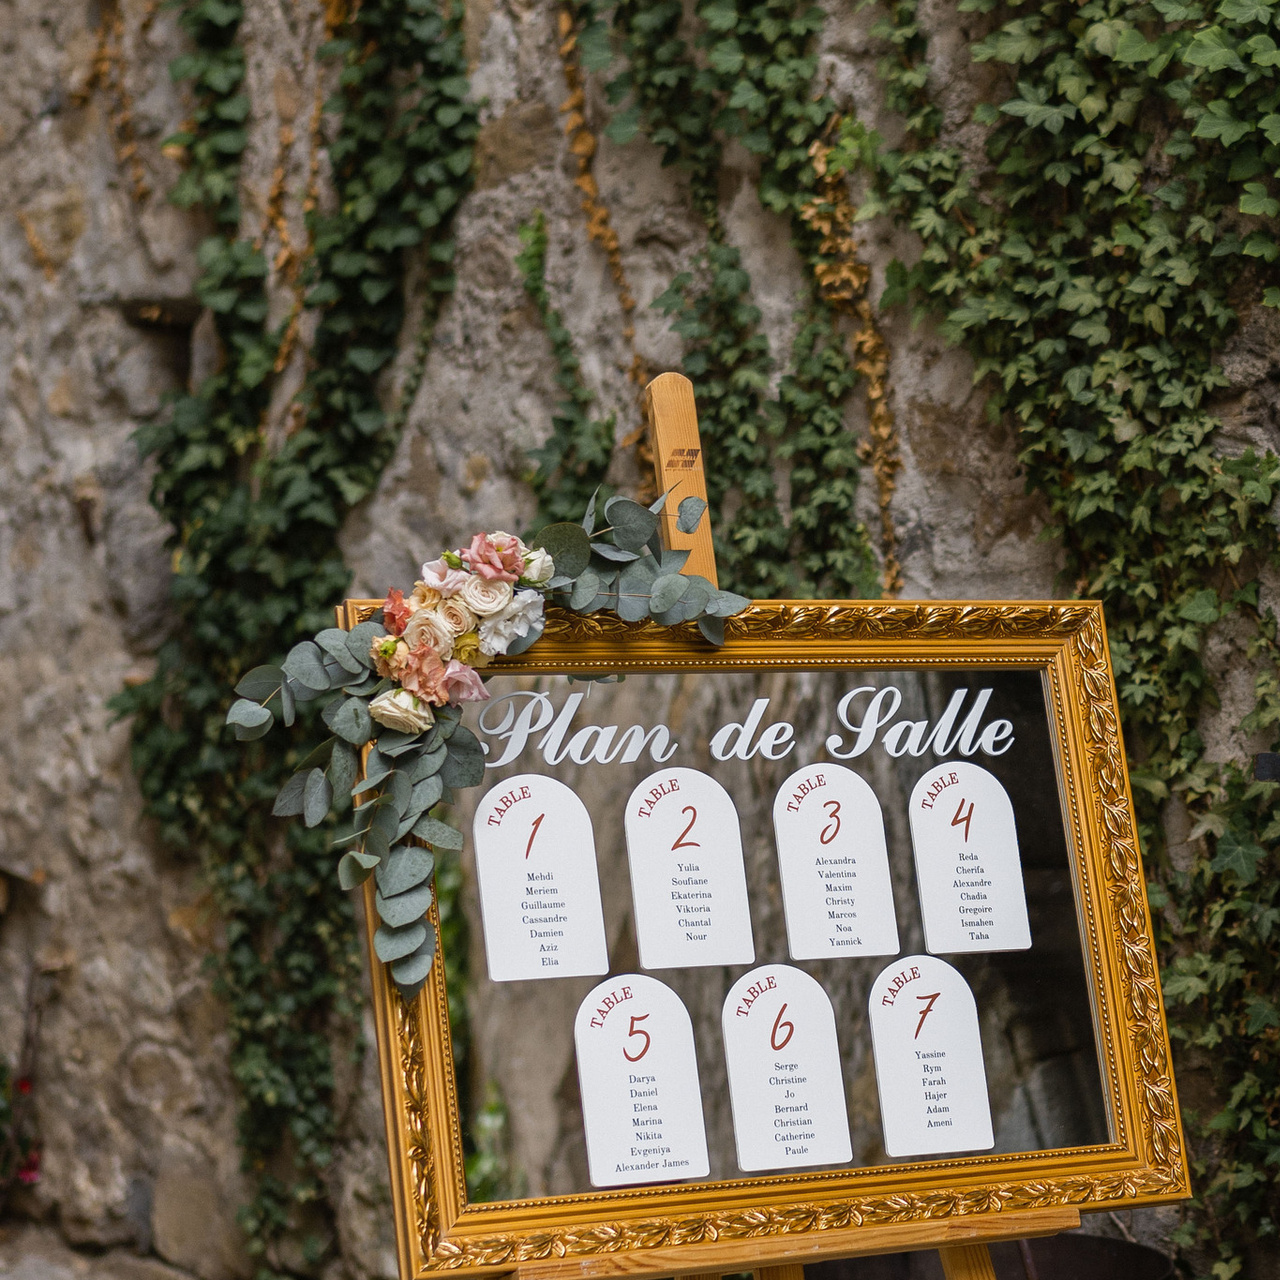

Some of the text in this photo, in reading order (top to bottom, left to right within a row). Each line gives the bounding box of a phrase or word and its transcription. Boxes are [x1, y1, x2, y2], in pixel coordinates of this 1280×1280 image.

[479, 686, 1015, 768] Plan de Salle
[787, 774, 826, 813] TABLE
[921, 772, 959, 810] TABLE
[638, 778, 680, 819] TABLE
[488, 785, 532, 827] TABLE
[820, 800, 841, 845] 3
[951, 798, 974, 843] 4
[671, 805, 701, 851] 2
[525, 813, 545, 860] 1
[815, 856, 856, 866] Alexandra
[959, 853, 978, 861] Reda
[677, 863, 700, 872] Yulia
[956, 866, 984, 874] Cherifa
[527, 872, 554, 882] Mehdi
[818, 871, 856, 879] Valentina
[672, 878, 708, 886] Soufiane
[953, 879, 992, 888] Alexandre
[526, 886, 558, 895] Meriem
[825, 884, 852, 892] Maxim
[671, 891, 712, 900] Ekaterina
[960, 892, 987, 900] Chadia
[521, 901, 566, 910] Guillaume
[825, 897, 855, 906] Christy
[676, 905, 711, 914] Viktoria
[959, 906, 992, 915] Gregoire
[522, 915, 568, 924] Cassandre
[828, 911, 856, 919] Marcos
[678, 918, 711, 927] Chantal
[961, 919, 994, 927] Ismahen
[836, 924, 852, 932] Noa
[530, 929, 564, 938] Damien
[686, 932, 707, 941] Nour
[969, 932, 989, 940] Taha
[829, 937, 862, 946] Yannick
[539, 944, 558, 952] Aziz
[541, 958, 559, 966] Elia
[882, 966, 921, 1007] TABLE
[736, 976, 777, 1018] TABLE
[590, 986, 633, 1029] TABLE
[914, 992, 941, 1040] 7
[770, 1003, 794, 1051] 6
[623, 1013, 651, 1062] 5
[915, 1050, 946, 1059] Yassine
[774, 1062, 798, 1072] Serge
[923, 1064, 942, 1073] Rym
[629, 1075, 656, 1084] Darya
[769, 1076, 807, 1086] Christine
[922, 1077, 946, 1087] Farah
[630, 1088, 658, 1098] Daniel
[785, 1090, 795, 1098] Jo
[925, 1092, 947, 1101] Hajer
[633, 1103, 658, 1112] Elena
[774, 1103, 808, 1114] Bernard
[926, 1106, 950, 1114] Adam
[632, 1117, 663, 1127] Marina
[774, 1118, 812, 1128] Christian
[927, 1118, 952, 1128] Ameni
[636, 1132, 662, 1141] Nikita
[774, 1132, 815, 1142] Catherine
[630, 1146, 671, 1157] Evgeniya
[785, 1146, 809, 1155] Paule
[615, 1159, 689, 1172] Alexander James
